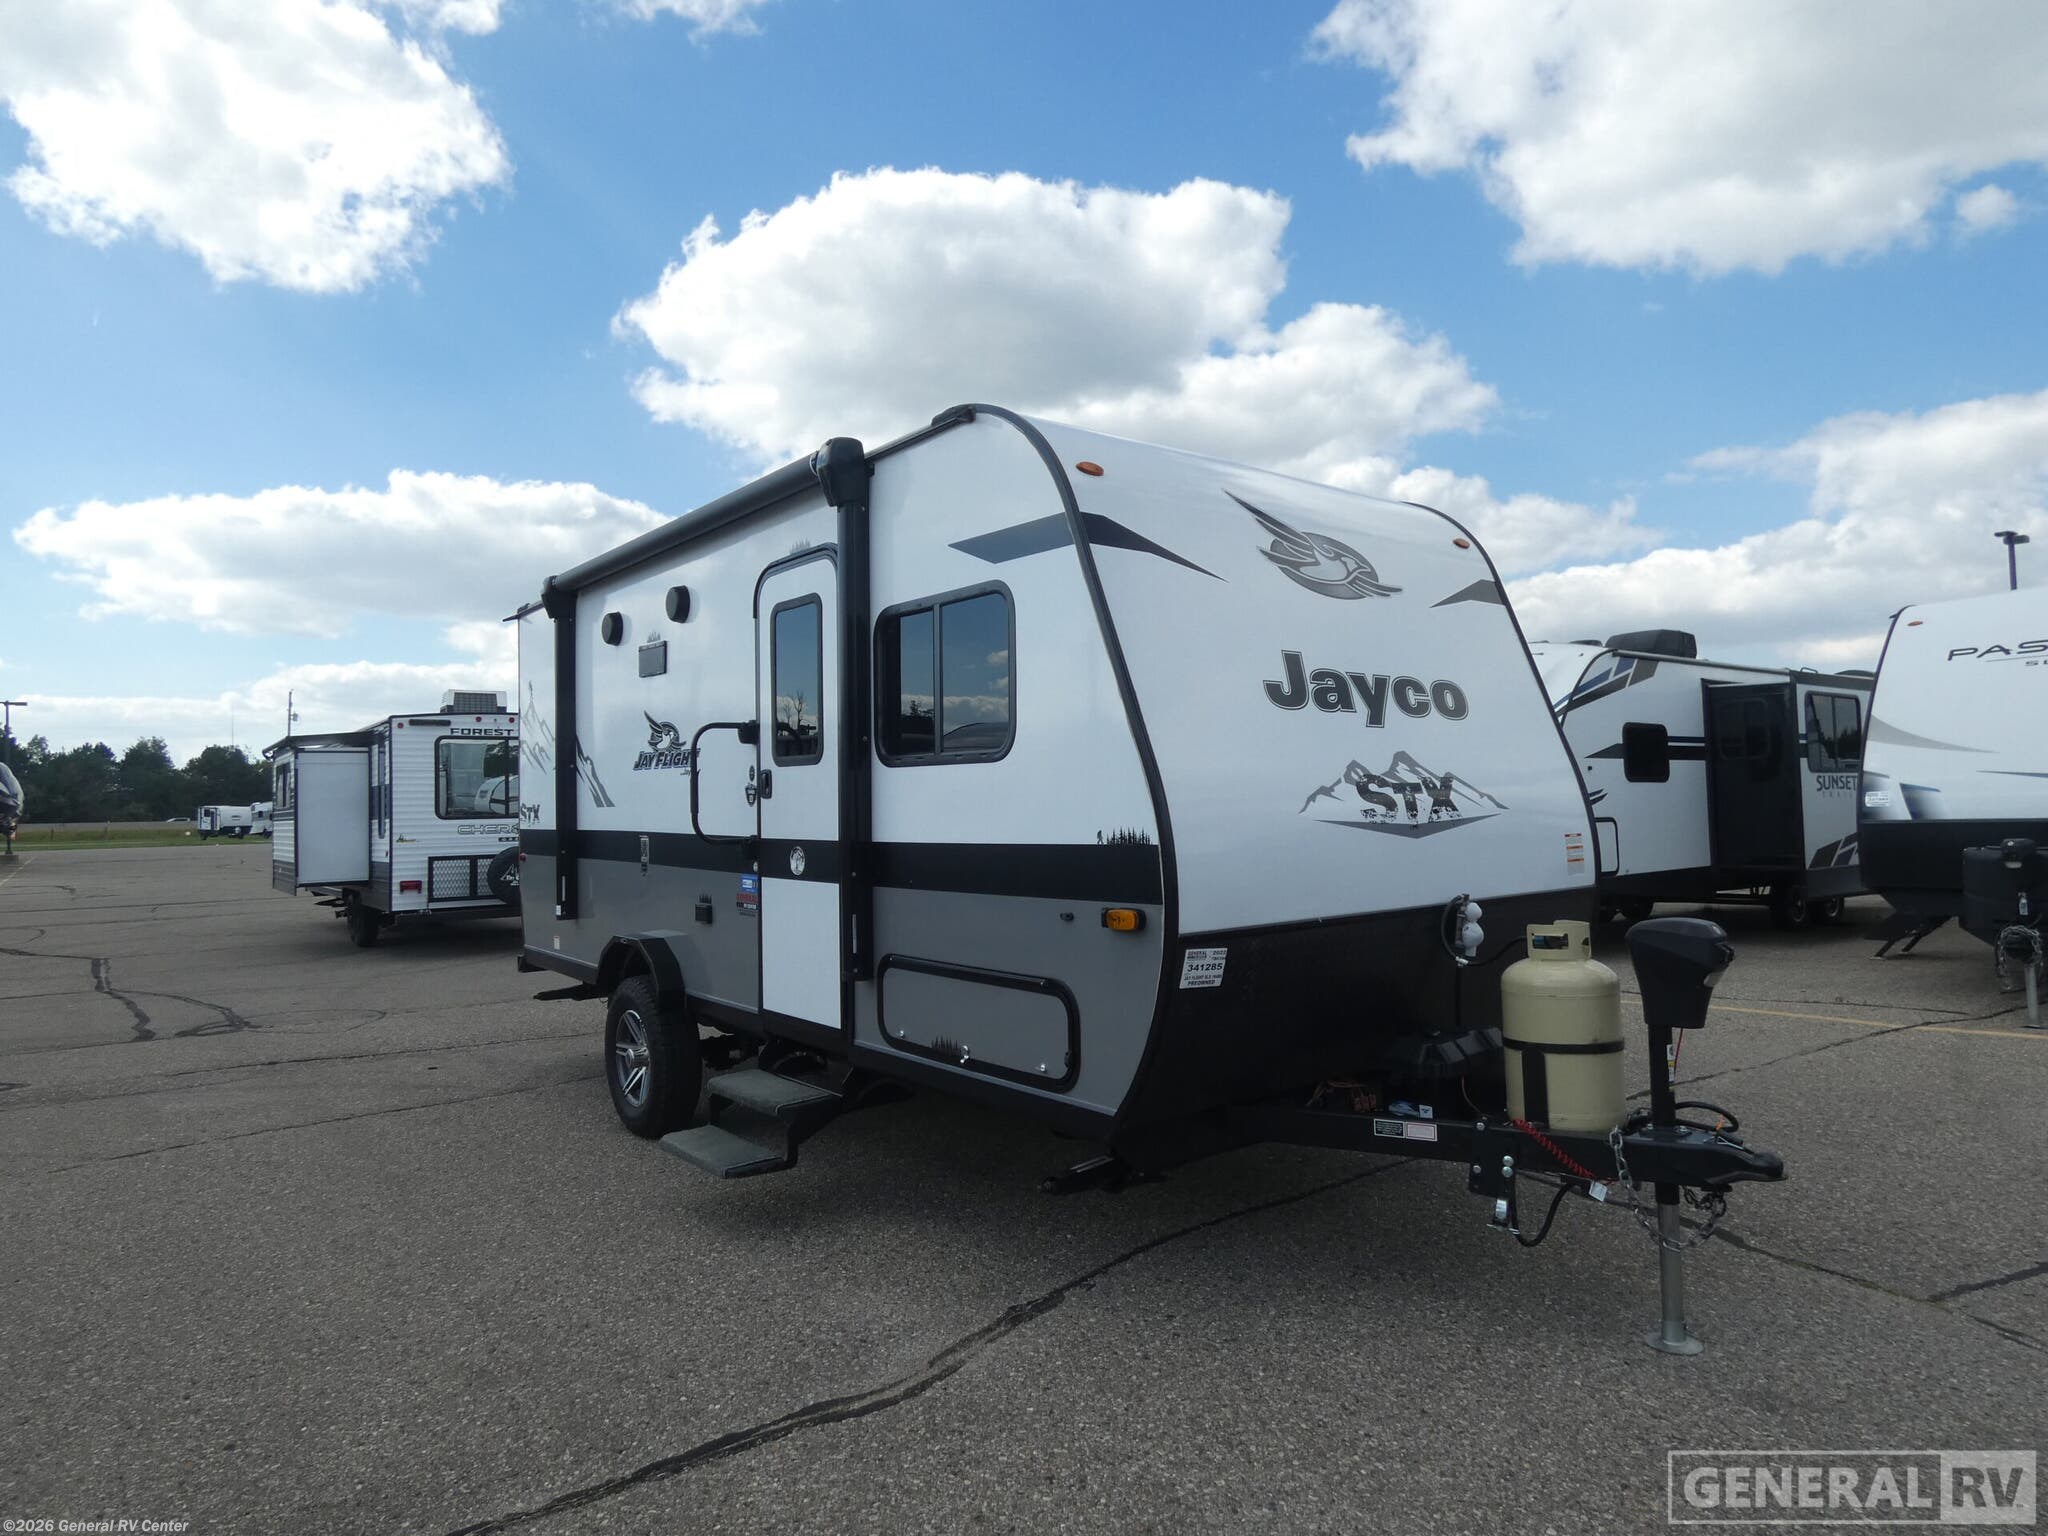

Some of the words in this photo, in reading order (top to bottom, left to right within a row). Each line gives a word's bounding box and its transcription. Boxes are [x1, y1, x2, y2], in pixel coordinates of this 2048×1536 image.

[1262, 650, 1469, 728] Jayco
[450, 728, 514, 736] FOREST
[633, 751, 656, 770] JAY
[1816, 775, 1858, 792] SUNSET
[1355, 773, 1463, 826] STX
[520, 803, 540, 824] STX
[1187, 962, 1223, 972] 341285
